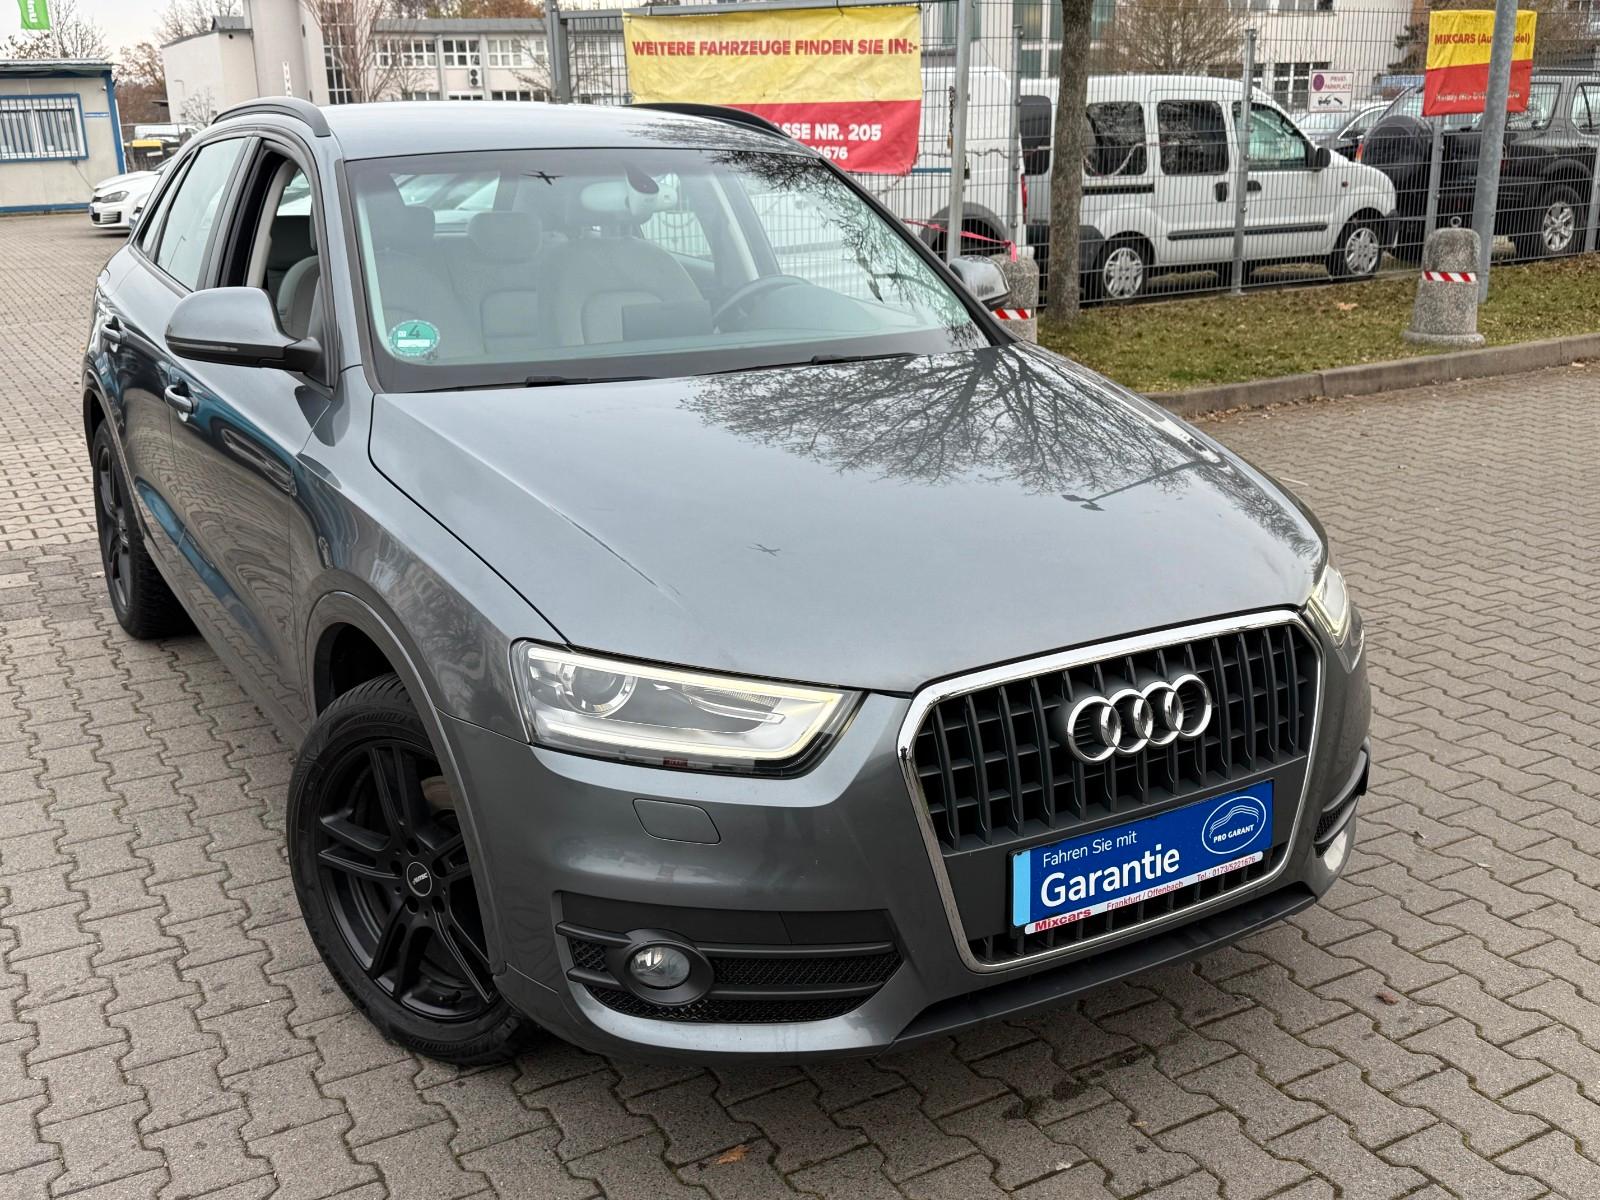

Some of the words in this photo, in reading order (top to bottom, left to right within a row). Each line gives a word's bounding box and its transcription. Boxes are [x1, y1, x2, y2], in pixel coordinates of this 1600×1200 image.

[632, 41, 695, 56] WEITERE
[699, 40, 791, 56] FAHRZEUGE
[795, 39, 854, 55] FINDEN
[857, 39, 884, 54] SIE
[1434, 32, 1476, 45] MIXCARS
[815, 123, 844, 140] NR.
[848, 124, 882, 141] 205
[408, 324, 421, 338] 4
[1213, 833, 1227, 844] PRO
[1228, 824, 1255, 838] GARANT
[1043, 846, 1088, 868] Fahren
[1092, 838, 1112, 854] Sie
[1116, 831, 1137, 848] mit
[1041, 844, 1180, 907] Garantie
[1034, 908, 1092, 931] Mixcars
[1106, 894, 1141, 910] Frankfurt
[1147, 880, 1184, 898] Offenbach
